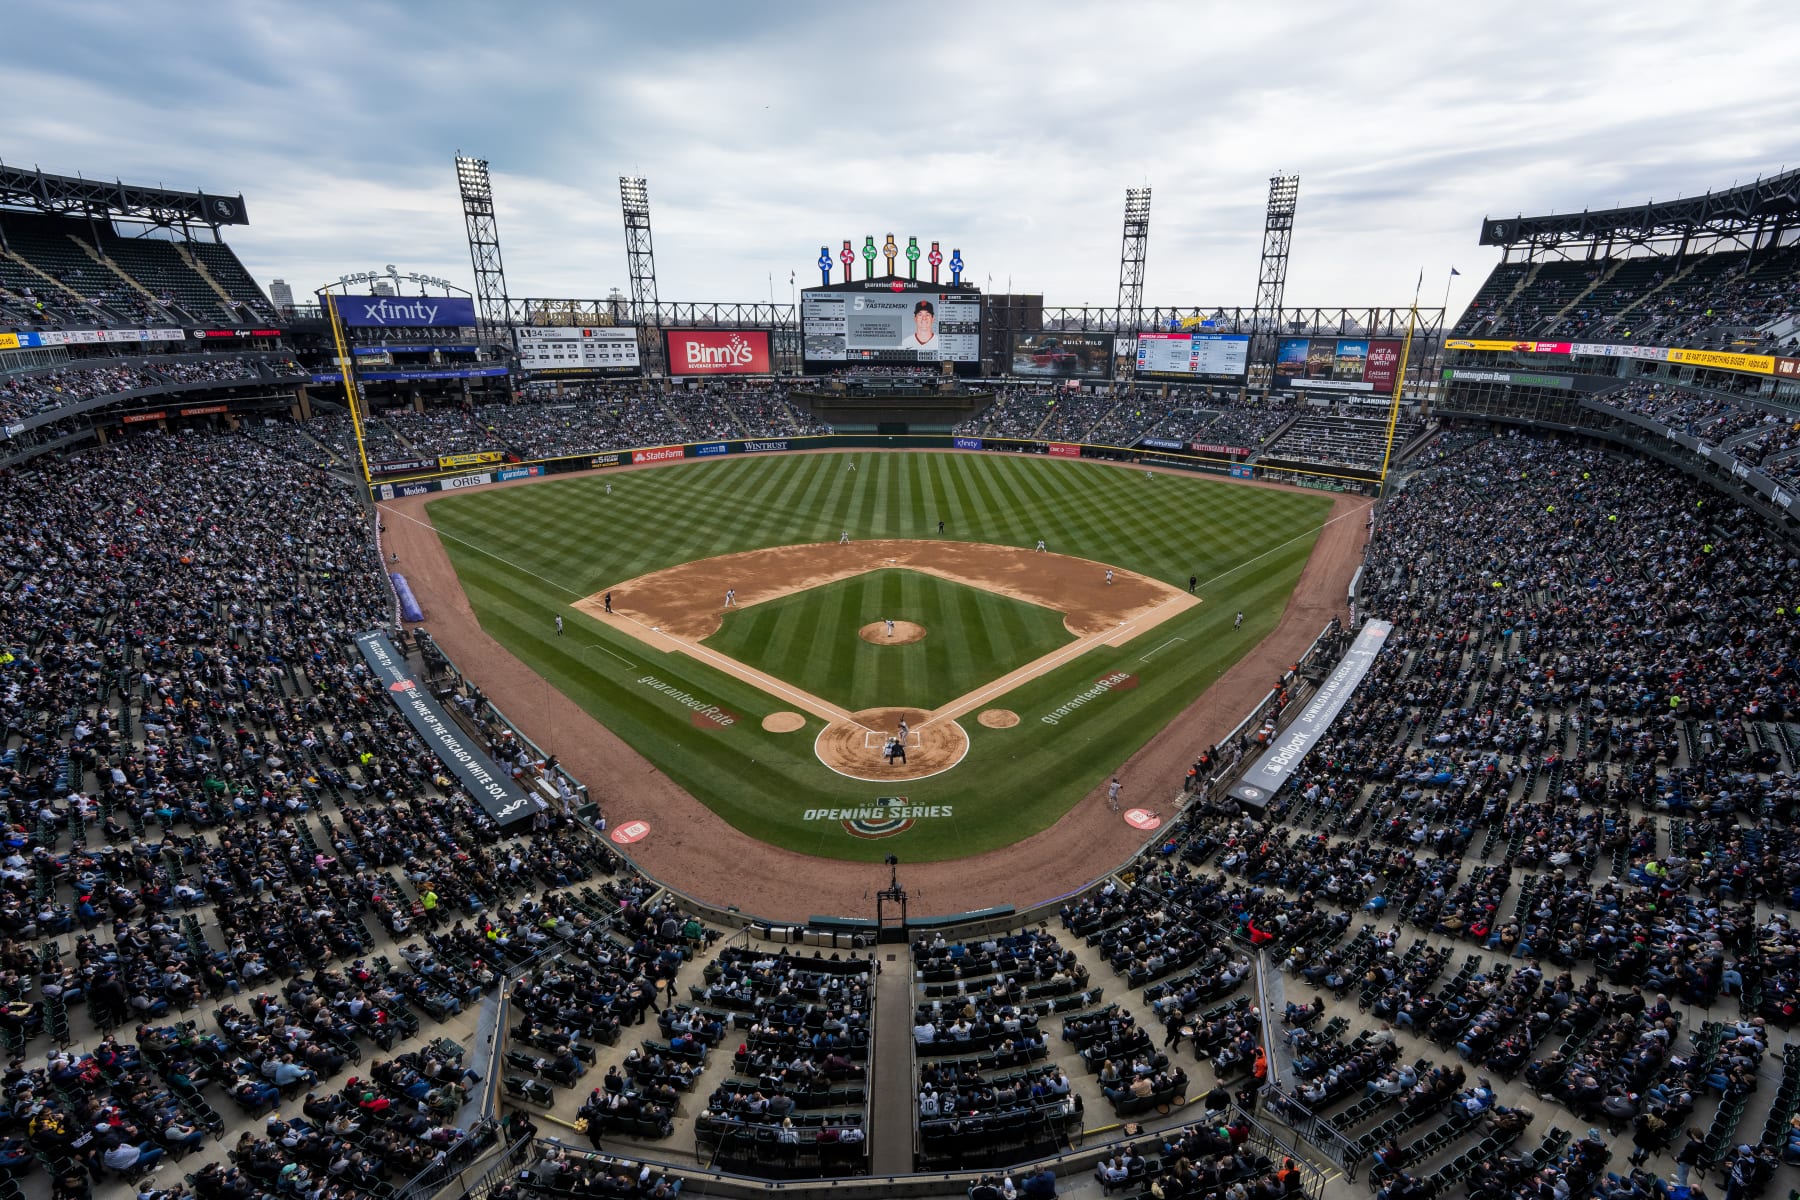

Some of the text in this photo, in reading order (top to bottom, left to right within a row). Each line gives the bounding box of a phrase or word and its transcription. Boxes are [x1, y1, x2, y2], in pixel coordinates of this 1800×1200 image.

[339, 270, 380, 286] KIDS
[408, 272, 451, 290] ZONE
[853, 296, 864, 310] 5
[364, 299, 438, 324] xfinity
[1453, 371, 1510, 381] Huntington Bank
[745, 442, 787, 450] WINTRUST
[957, 439, 978, 448] xfinity
[502, 468, 528, 480] guaranteed
[453, 476, 480, 487] ORIS
[404, 486, 427, 496] Modelo
[369, 640, 389, 660] WELCOME
[411, 700, 431, 716] HOME
[424, 715, 437, 724] OF
[431, 722, 448, 736] THE
[440, 734, 471, 761] CHICAGO
[465, 760, 492, 784] WHITE
[485, 783, 508, 800] SOX
[1271, 732, 1310, 770] Ballpark
[1302, 691, 1331, 722] DOWNLOAD
[1328, 678, 1340, 693] AND
[803, 806, 953, 820] OPENING SERIES
[924, 1101, 933, 1111] 10
[944, 1102, 954, 1112] 27
